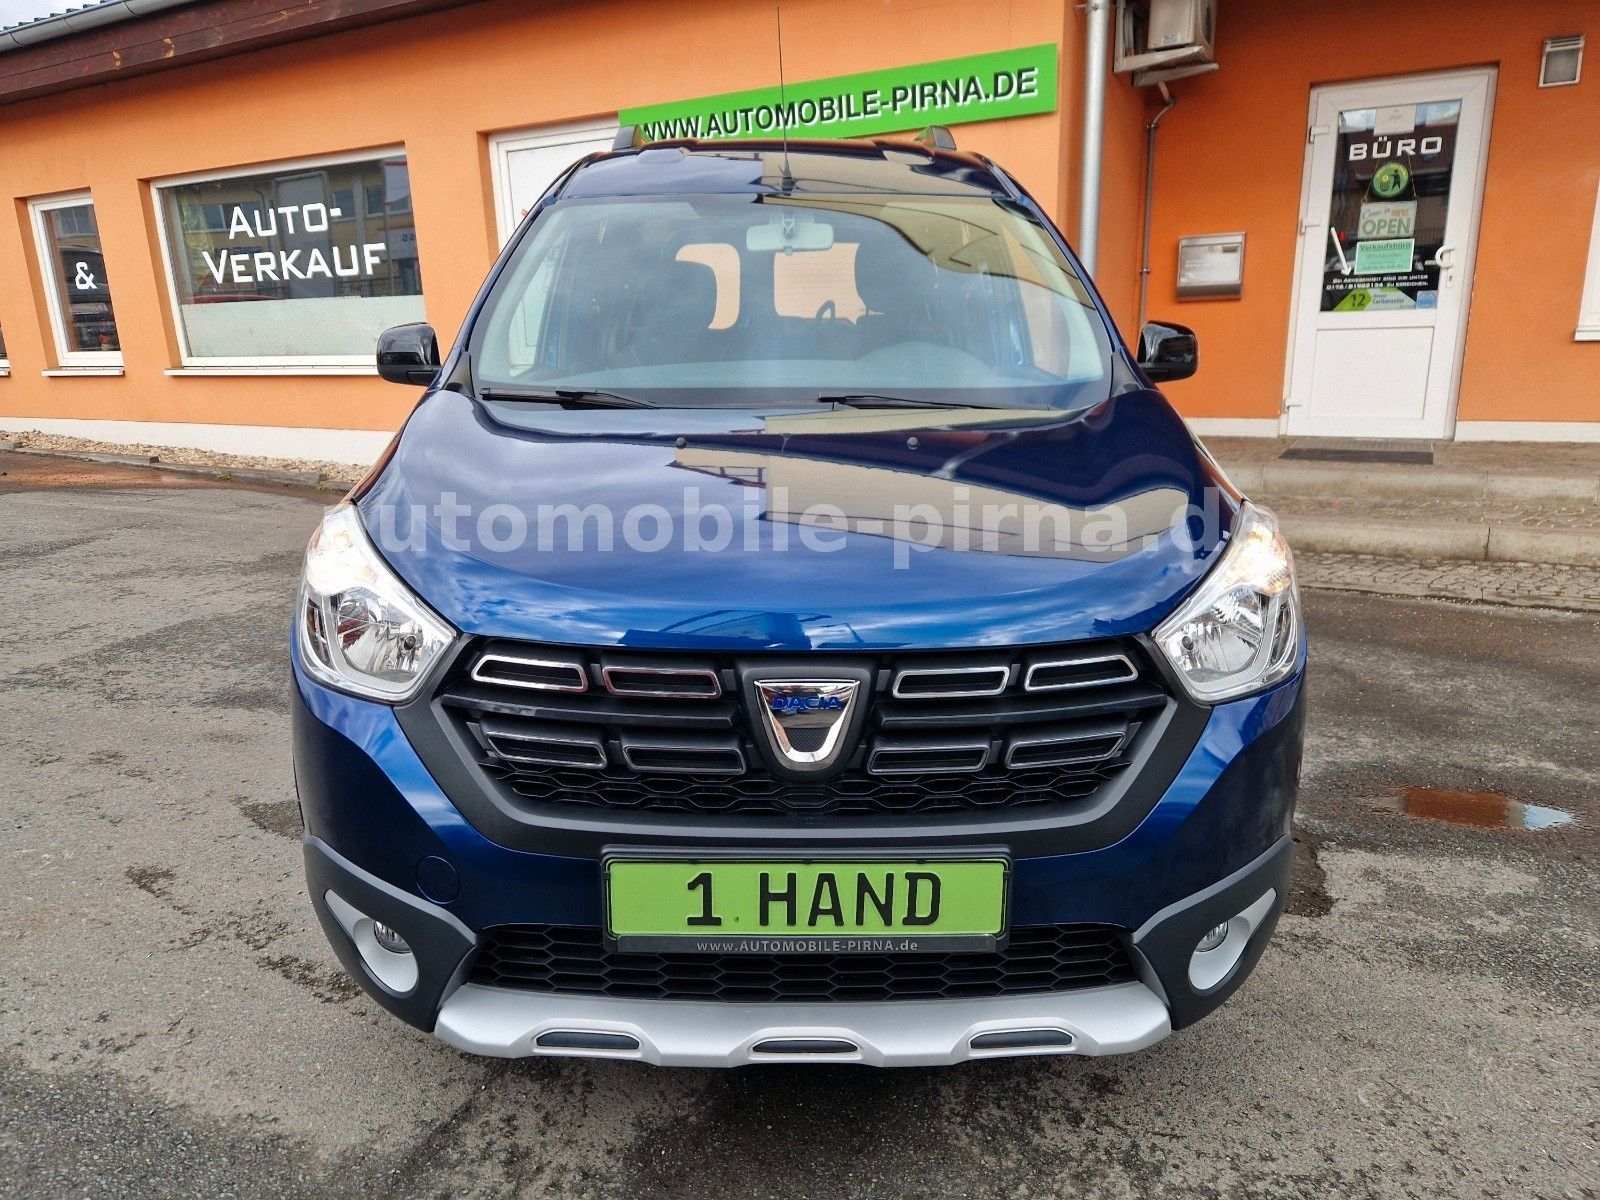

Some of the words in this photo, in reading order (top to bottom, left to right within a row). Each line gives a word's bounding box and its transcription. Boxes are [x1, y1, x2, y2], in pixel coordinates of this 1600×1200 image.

[1349, 136, 1443, 161] BÜRO
[228, 203, 342, 240] AUTO-
[1362, 217, 1412, 235] OPEN
[75, 261, 97, 290] &
[201, 242, 386, 285] VERKAUF
[773, 696, 842, 710] DACIA
[686, 872, 723, 926] 1
[758, 872, 942, 926] HAND
[696, 939, 919, 953] www.AUTOMOBILE-PIRNA.de
